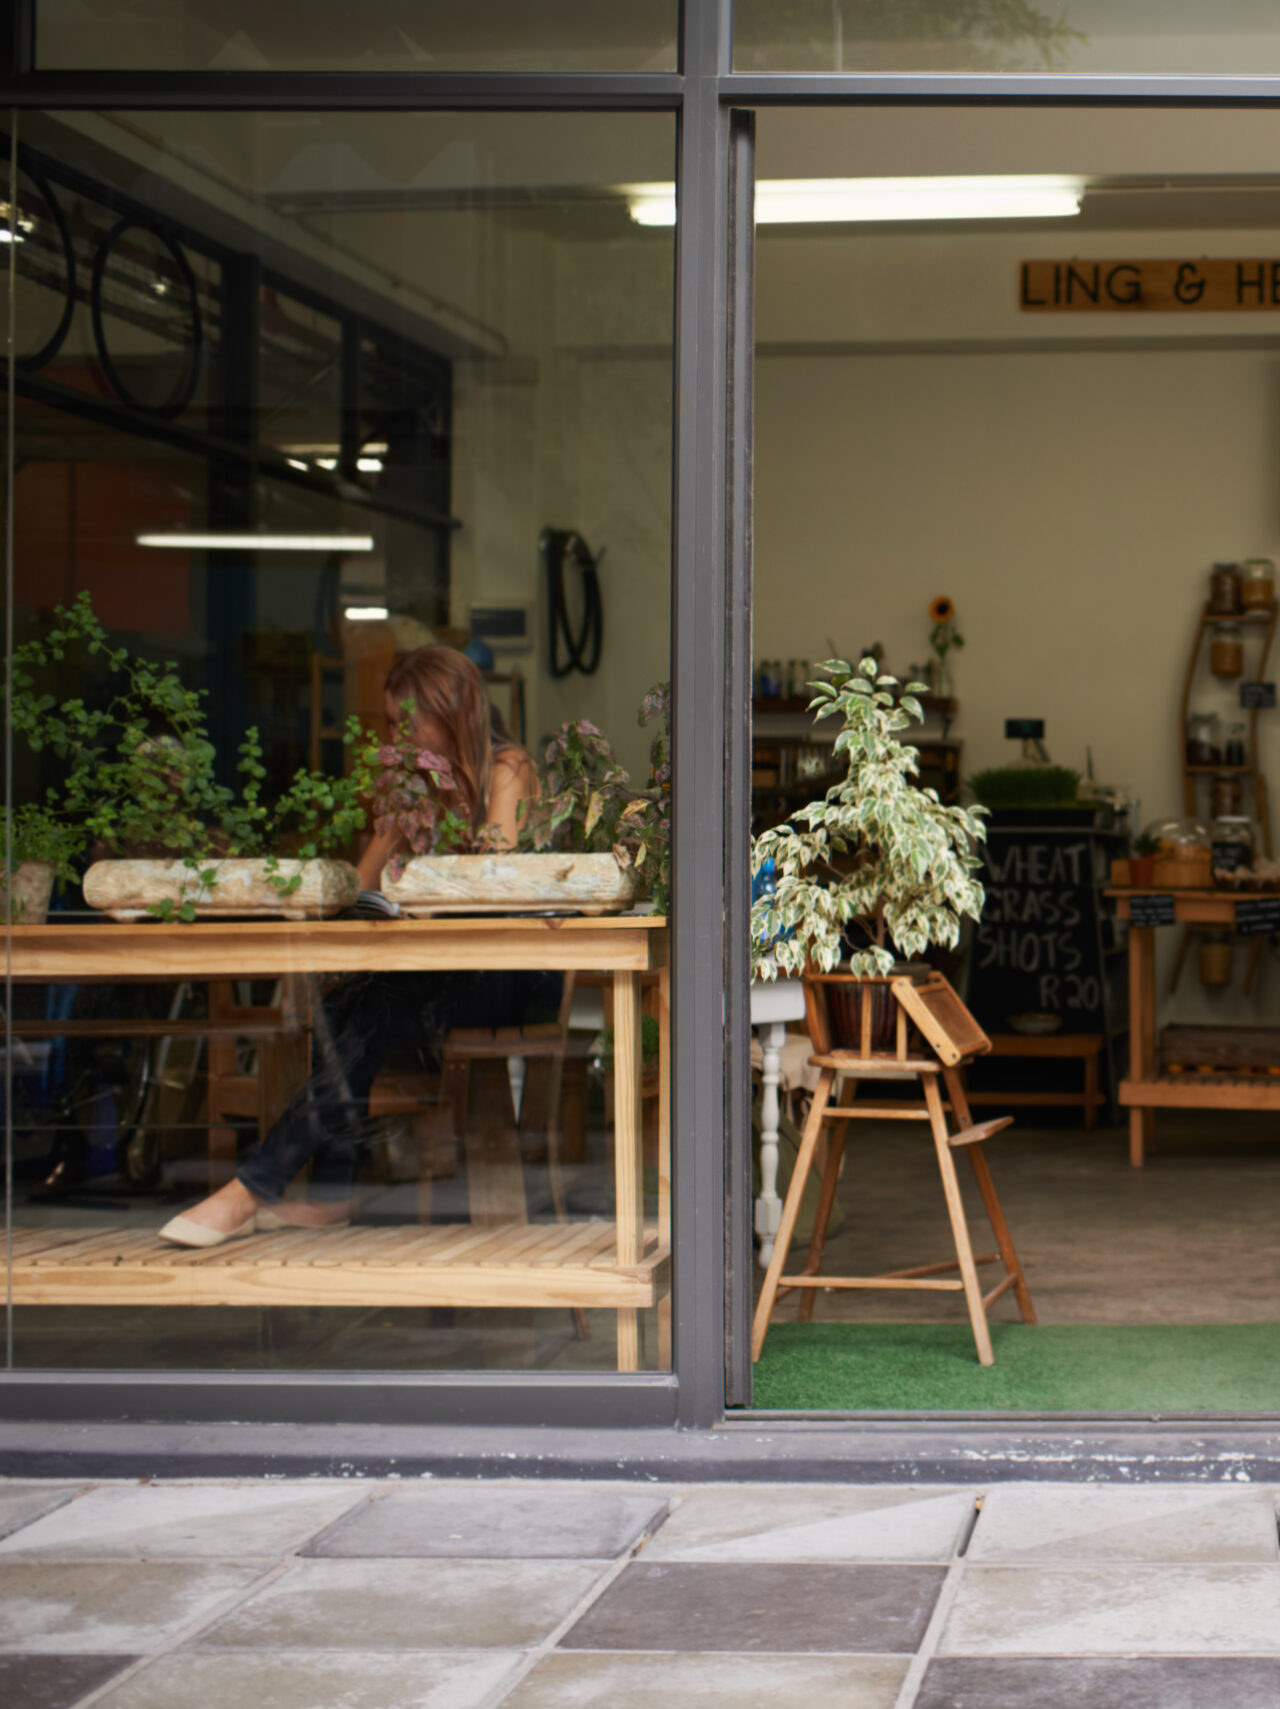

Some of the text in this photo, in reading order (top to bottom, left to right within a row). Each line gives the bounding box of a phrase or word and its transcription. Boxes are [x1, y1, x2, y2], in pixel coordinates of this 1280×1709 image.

[1022, 264, 1142, 305] LING
[1173, 262, 1206, 304] &
[982, 843, 1088, 885] WHEAT
[982, 887, 1082, 927] GRASS
[977, 926, 1083, 973] SHOTS
